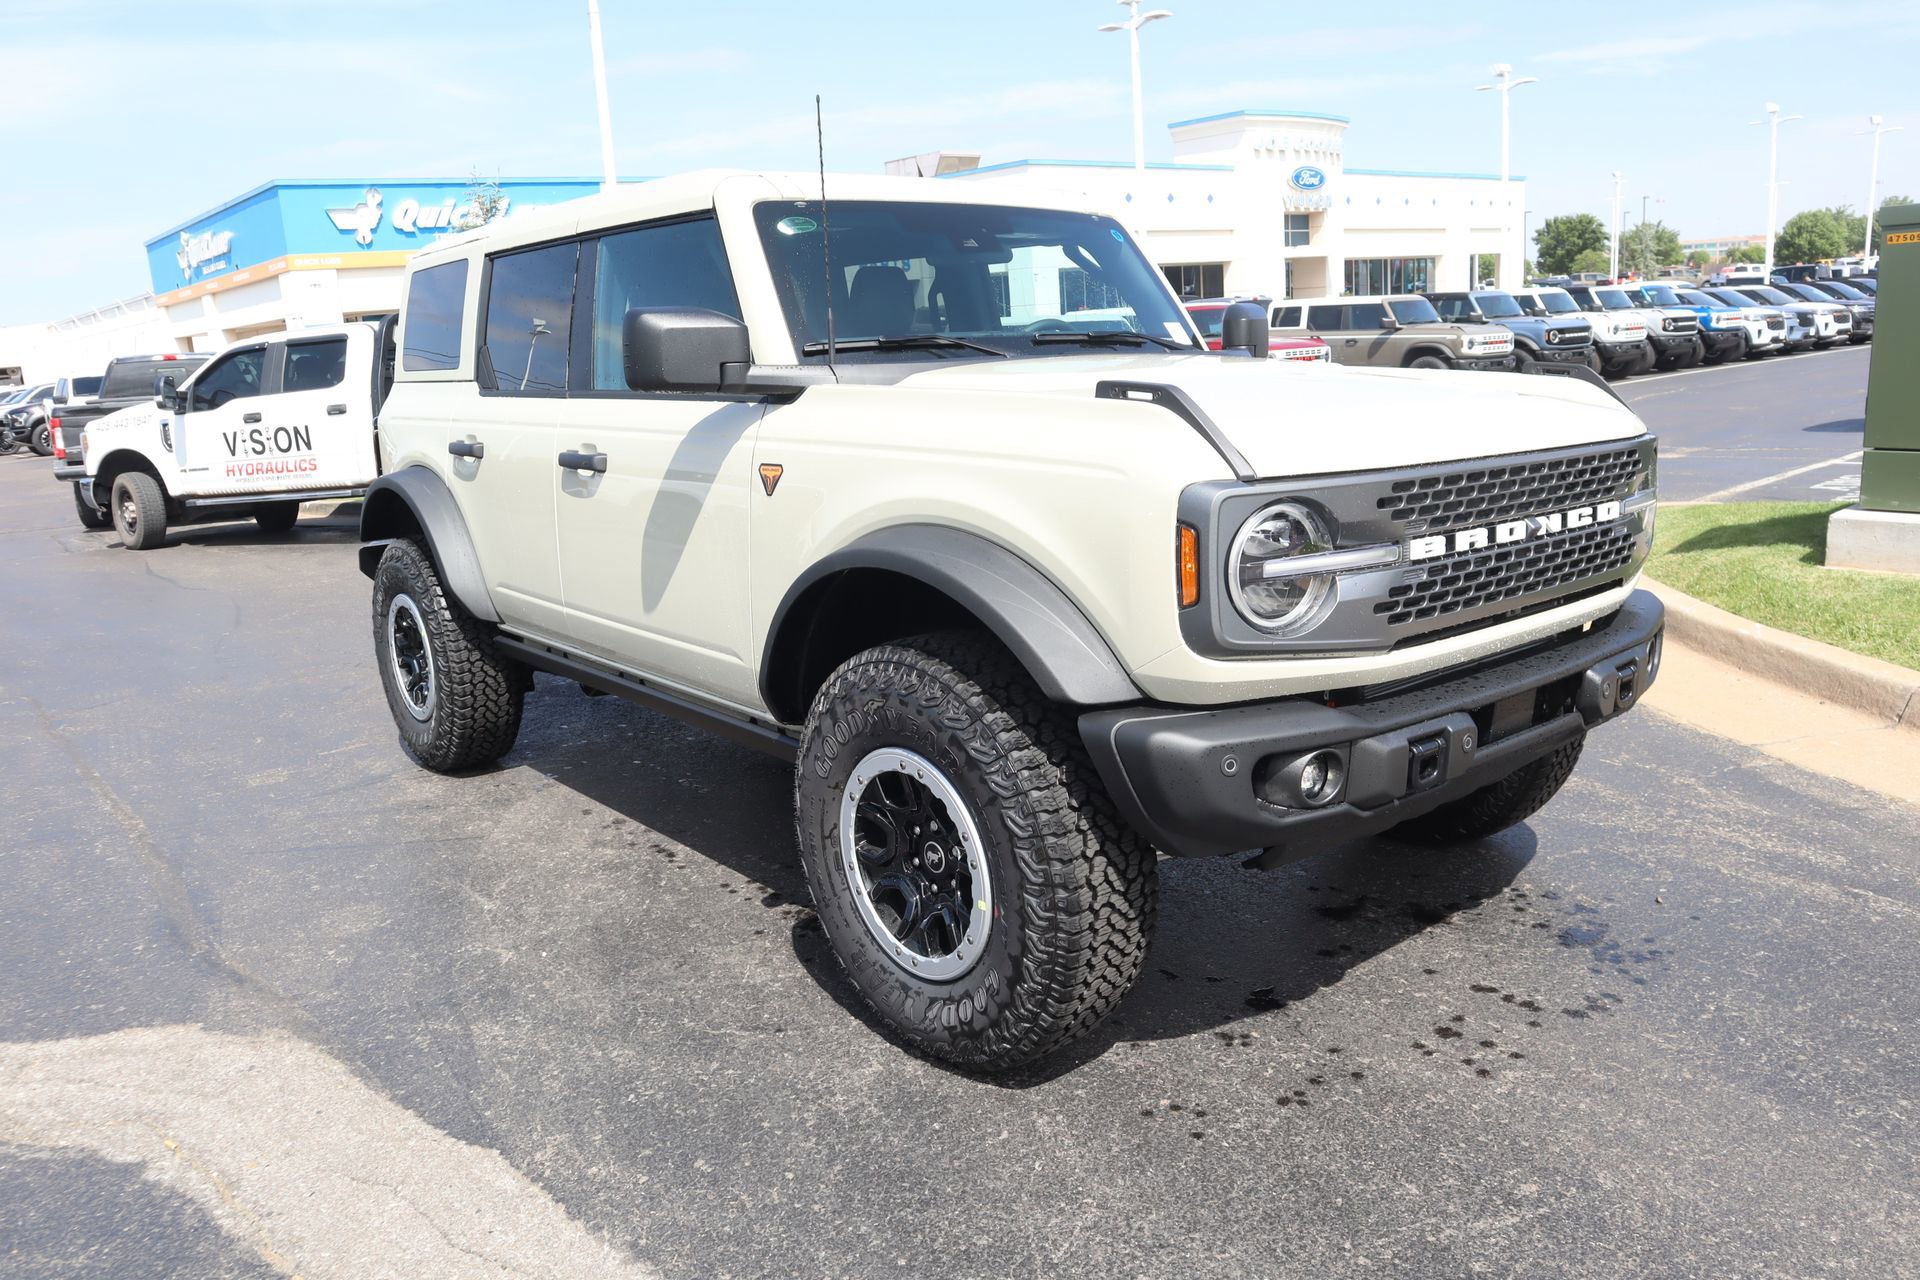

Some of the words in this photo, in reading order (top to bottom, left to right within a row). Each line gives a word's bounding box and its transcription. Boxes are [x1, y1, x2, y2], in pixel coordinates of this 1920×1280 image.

[1298, 168, 1321, 186] Ford
[392, 197, 494, 234] Quic
[222, 424, 312, 457] VISION
[226, 458, 318, 477] HYDRAULICS
[1409, 500, 1620, 561] BRONCO
[814, 706, 963, 780] GOODYEAR
